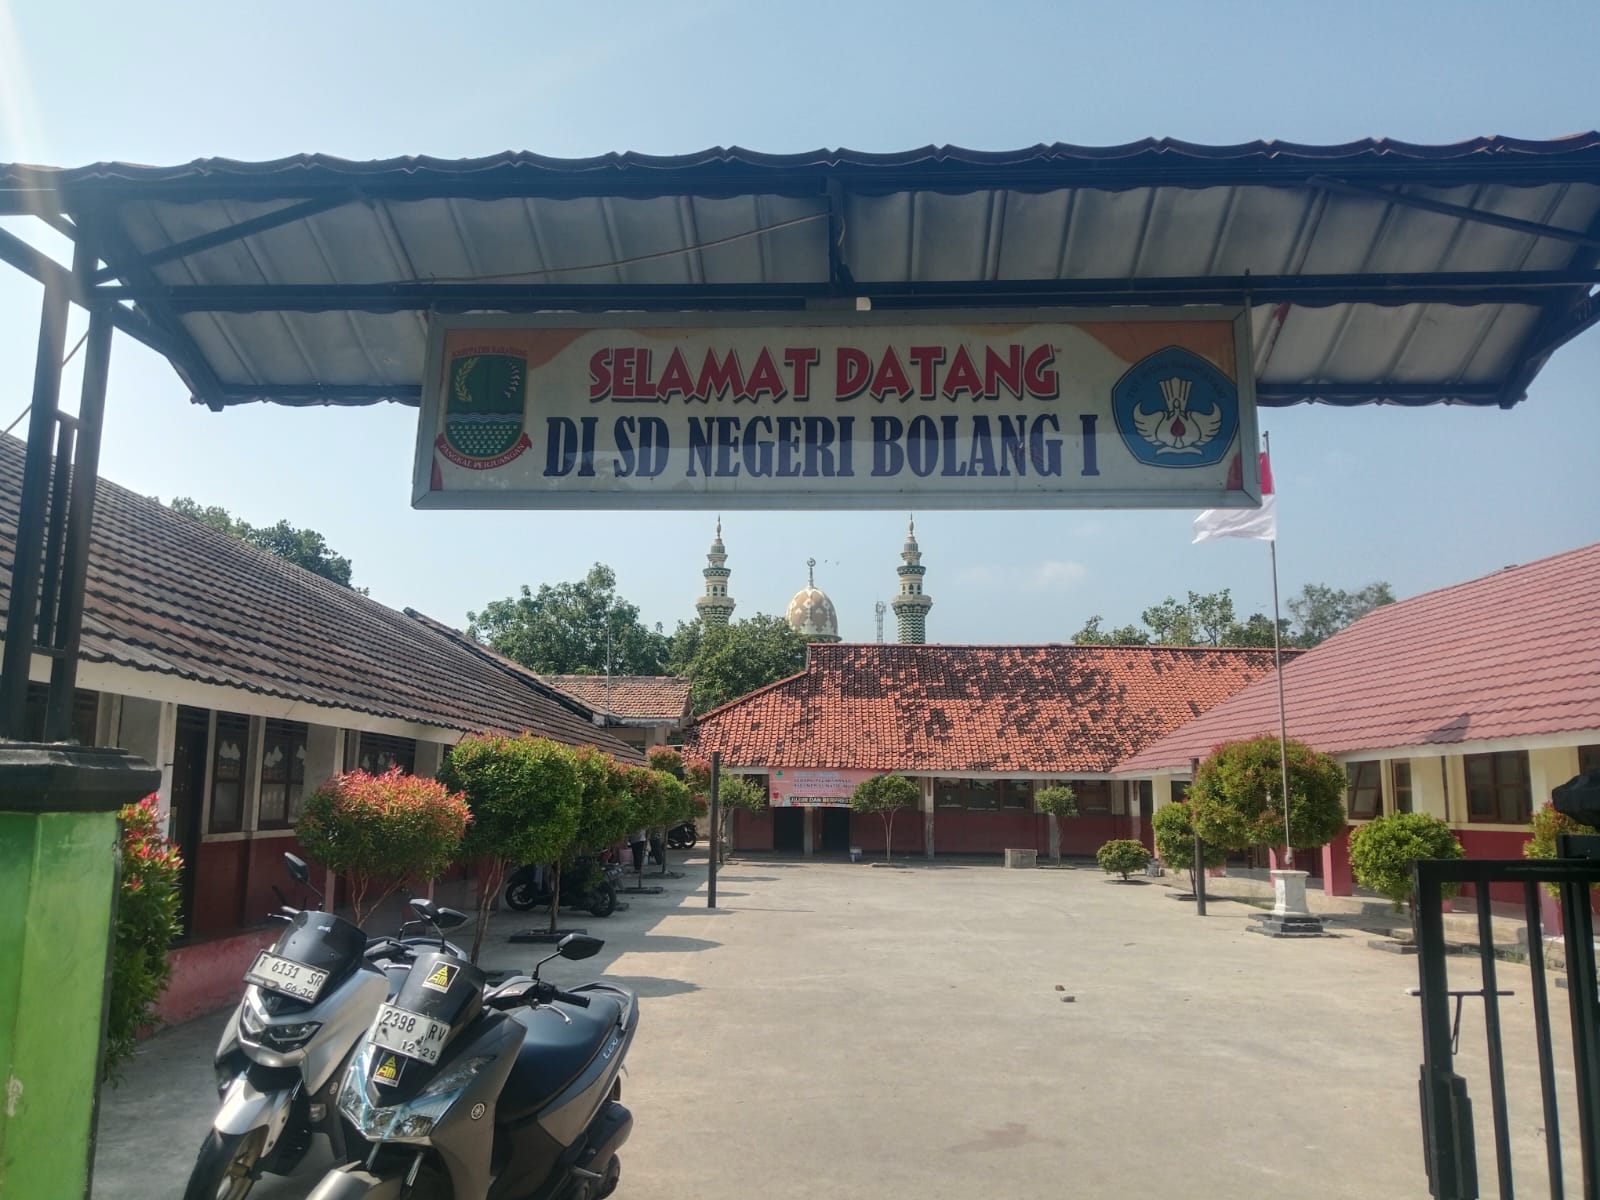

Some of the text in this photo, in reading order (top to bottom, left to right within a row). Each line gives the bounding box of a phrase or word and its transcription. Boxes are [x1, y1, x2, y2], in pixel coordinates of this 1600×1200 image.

[589, 343, 1060, 403] SELAMAT DATANG
[543, 414, 1100, 478] DI SD NEGERI BOLANG I
[259, 956, 324, 987] T 6131 SR
[381, 1010, 447, 1042] 2398 RV
